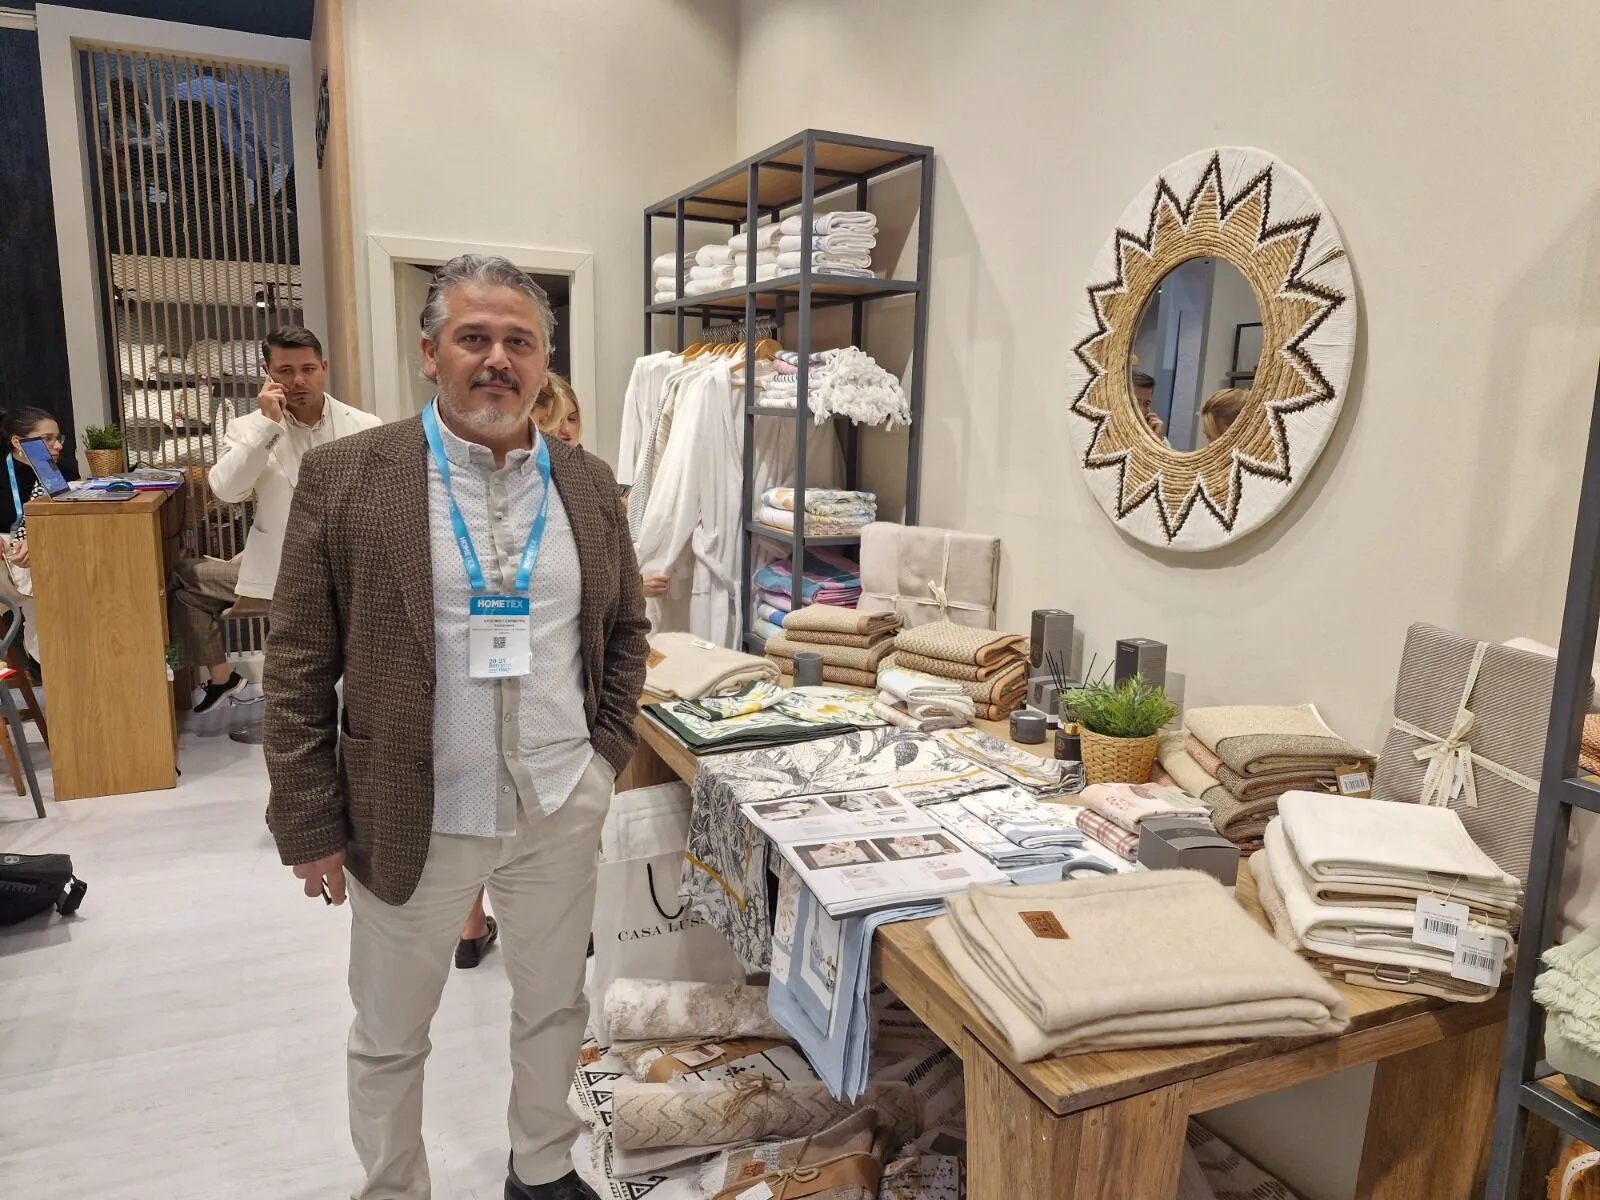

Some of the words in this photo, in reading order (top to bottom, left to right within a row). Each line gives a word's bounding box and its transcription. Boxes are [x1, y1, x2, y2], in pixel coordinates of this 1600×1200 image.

[477, 599, 523, 609] HOMETEX
[617, 925, 662, 942] CASA
[668, 917, 705, 933] LUS
